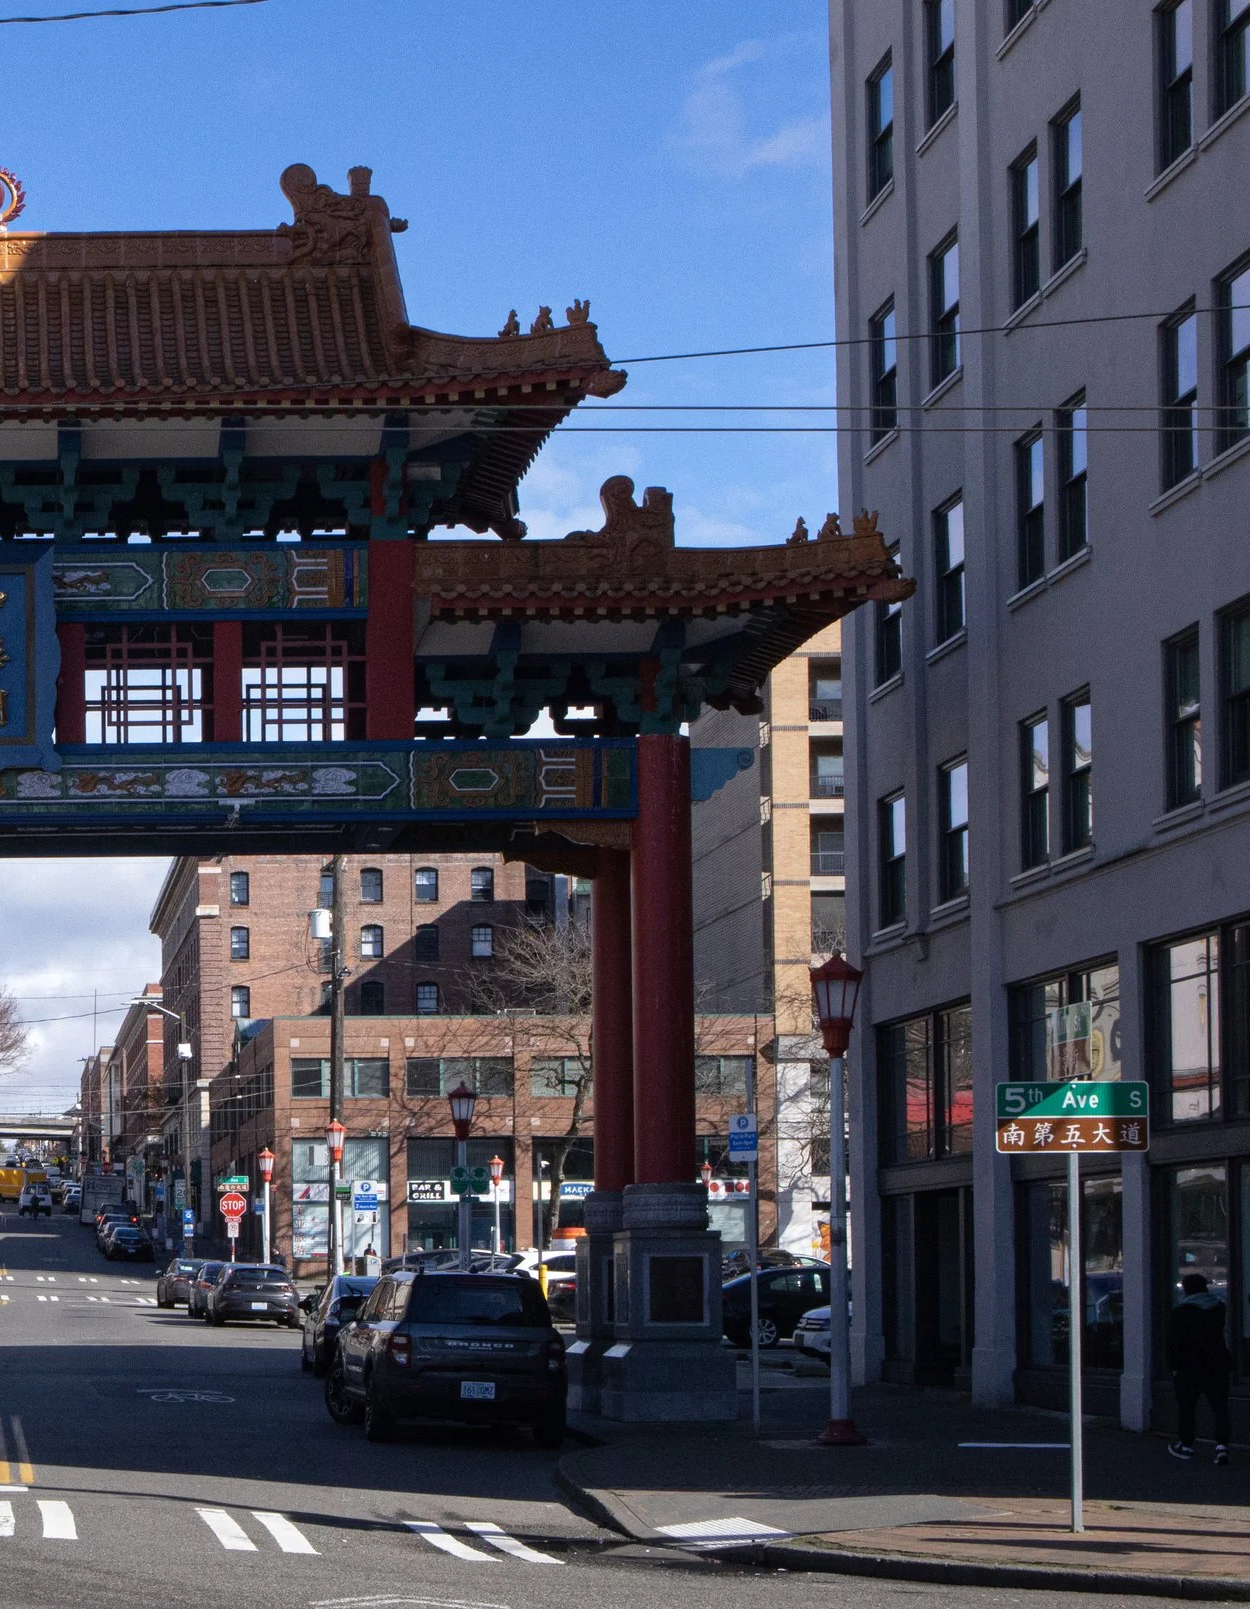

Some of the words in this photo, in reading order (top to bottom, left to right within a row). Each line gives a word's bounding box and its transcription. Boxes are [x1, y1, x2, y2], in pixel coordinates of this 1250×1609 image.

[1004, 1087, 1043, 1113] 5th
[1061, 1090, 1099, 1109] Ave
[1129, 1090, 1142, 1108] S
[1002, 1121, 1143, 1147] 南第五大道
[411, 1183, 431, 1191] BAR
[433, 1183, 443, 1191] &
[412, 1192, 441, 1200] GRILL
[221, 1200, 245, 1211] STOP
